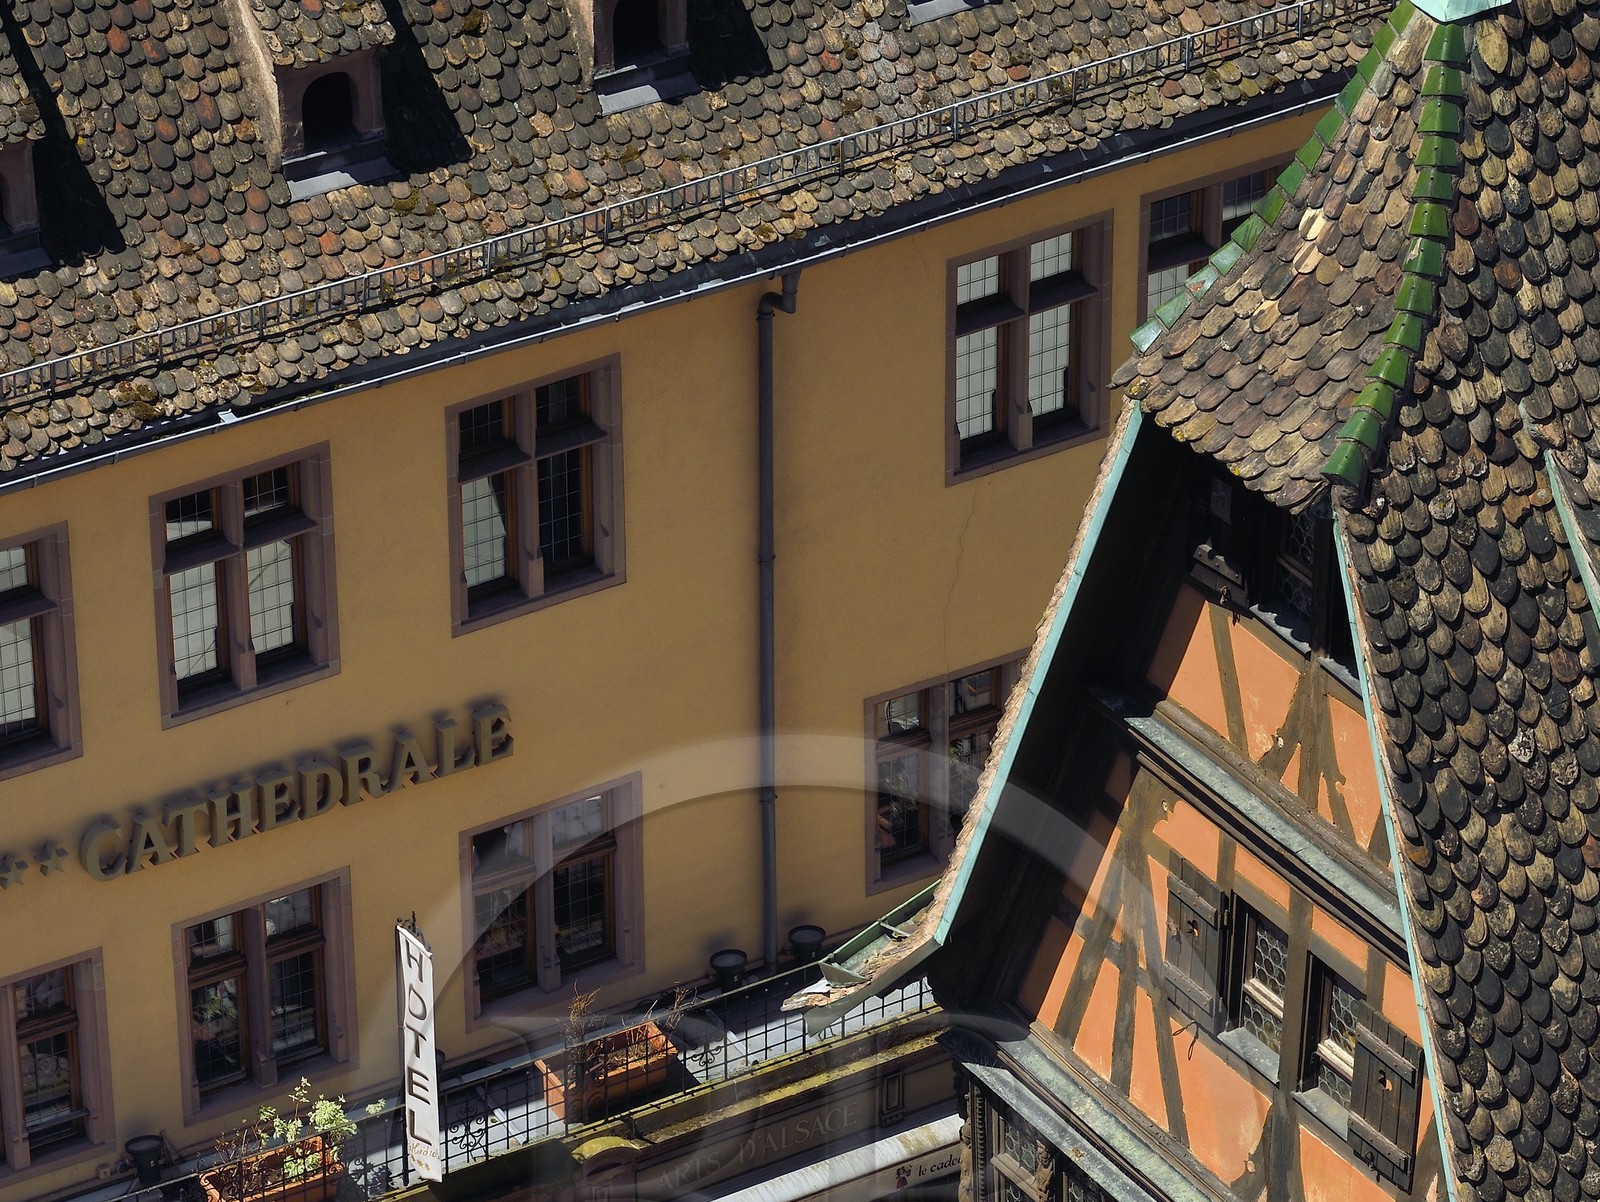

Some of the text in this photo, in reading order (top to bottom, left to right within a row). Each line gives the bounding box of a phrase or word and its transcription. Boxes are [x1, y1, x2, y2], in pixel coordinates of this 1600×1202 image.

[80, 704, 514, 882] CATHEDRALE
[404, 938, 433, 1147] HOTEL
[657, 1102, 859, 1195] ARTS D'ALSACE
[918, 1165, 927, 1177] le
